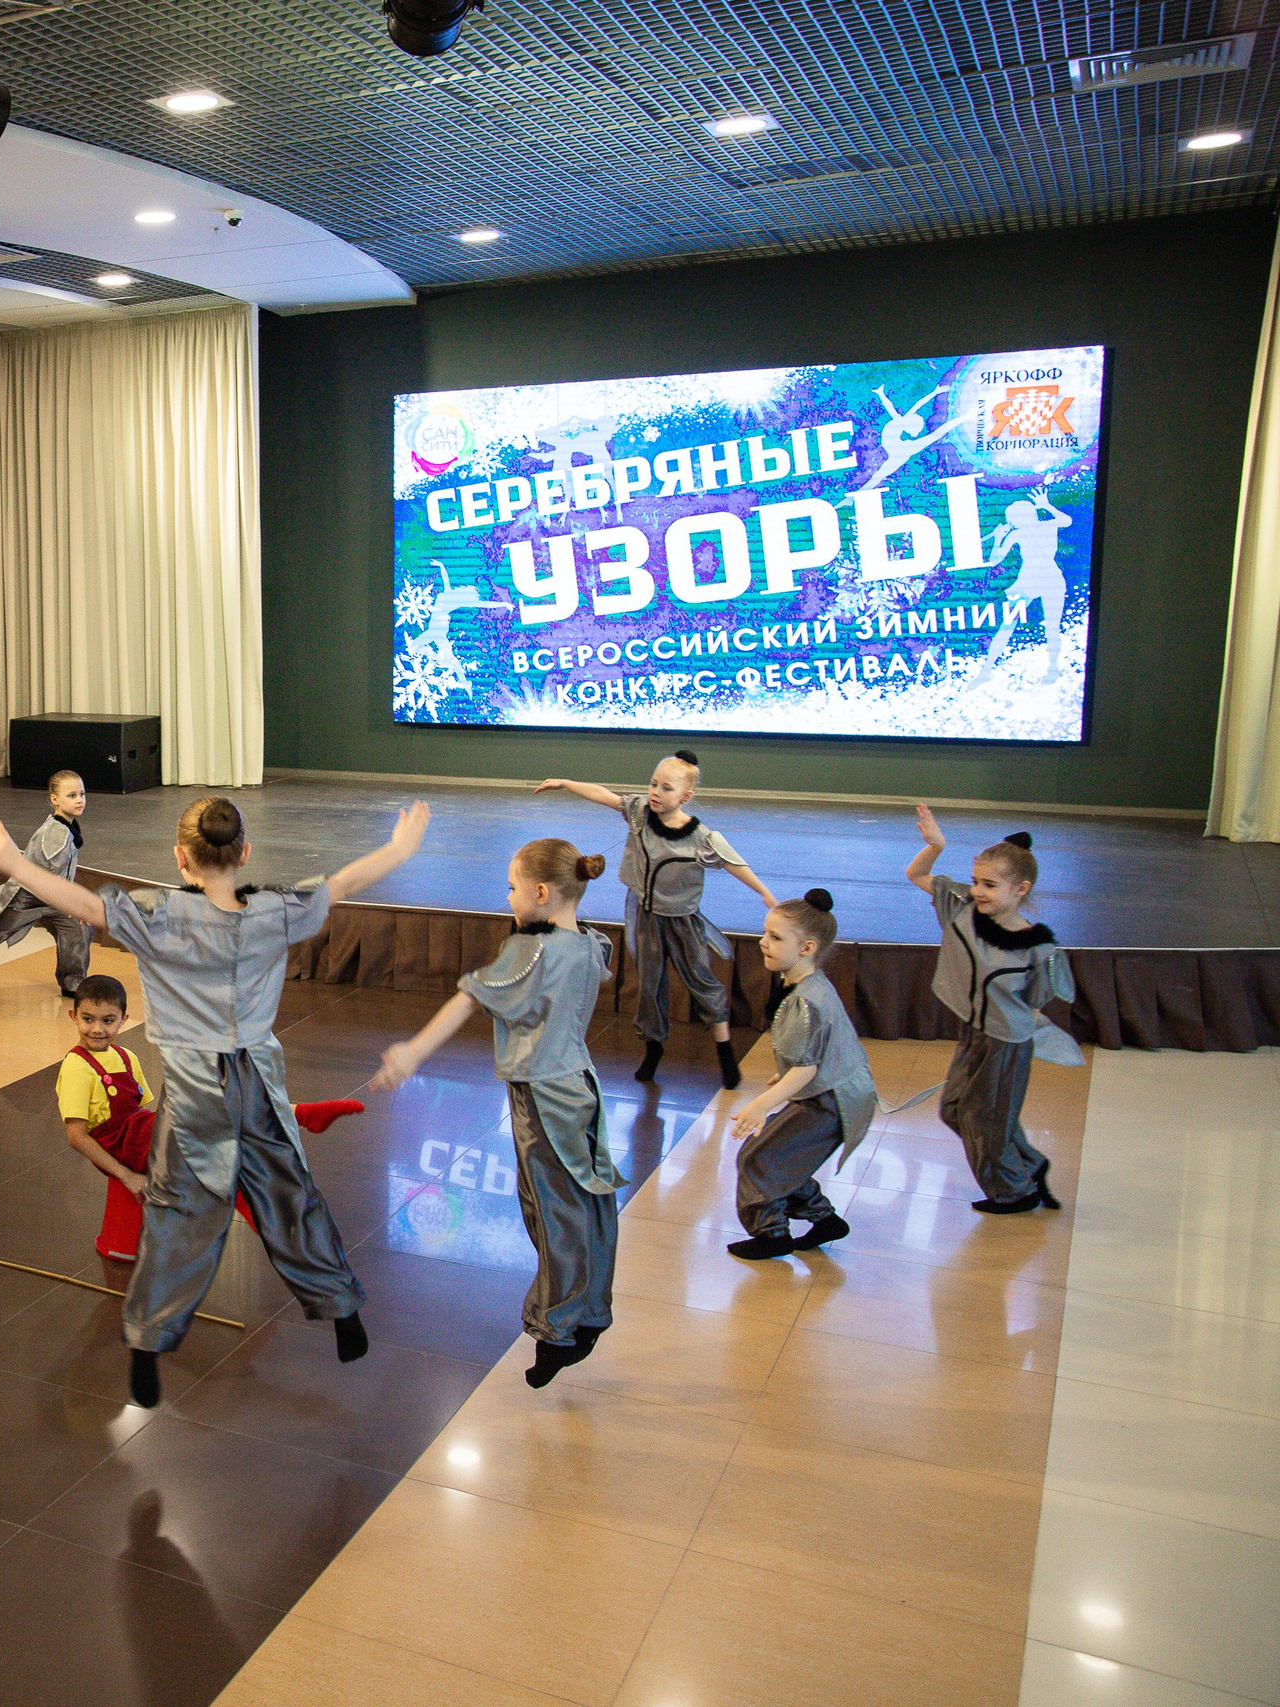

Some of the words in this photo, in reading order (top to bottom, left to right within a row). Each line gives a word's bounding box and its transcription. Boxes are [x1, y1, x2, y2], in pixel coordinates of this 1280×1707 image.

[980, 367, 1063, 385] ЯРКОФФ
[421, 440, 458, 452] СИТИ
[422, 426, 458, 441] САН
[986, 436, 1080, 451] КОРПОРАЦИЯ
[426, 421, 858, 533] СЕРЕБРЯНЫЕ
[502, 472, 994, 625] УЗОРЫ
[513, 615, 837, 674] ВСЕРОССИЙСКИЙ
[855, 595, 1028, 641] ЗИМНИЙ
[556, 647, 967, 703] КОНКУРС-ФЕСТИВАЛЬ
